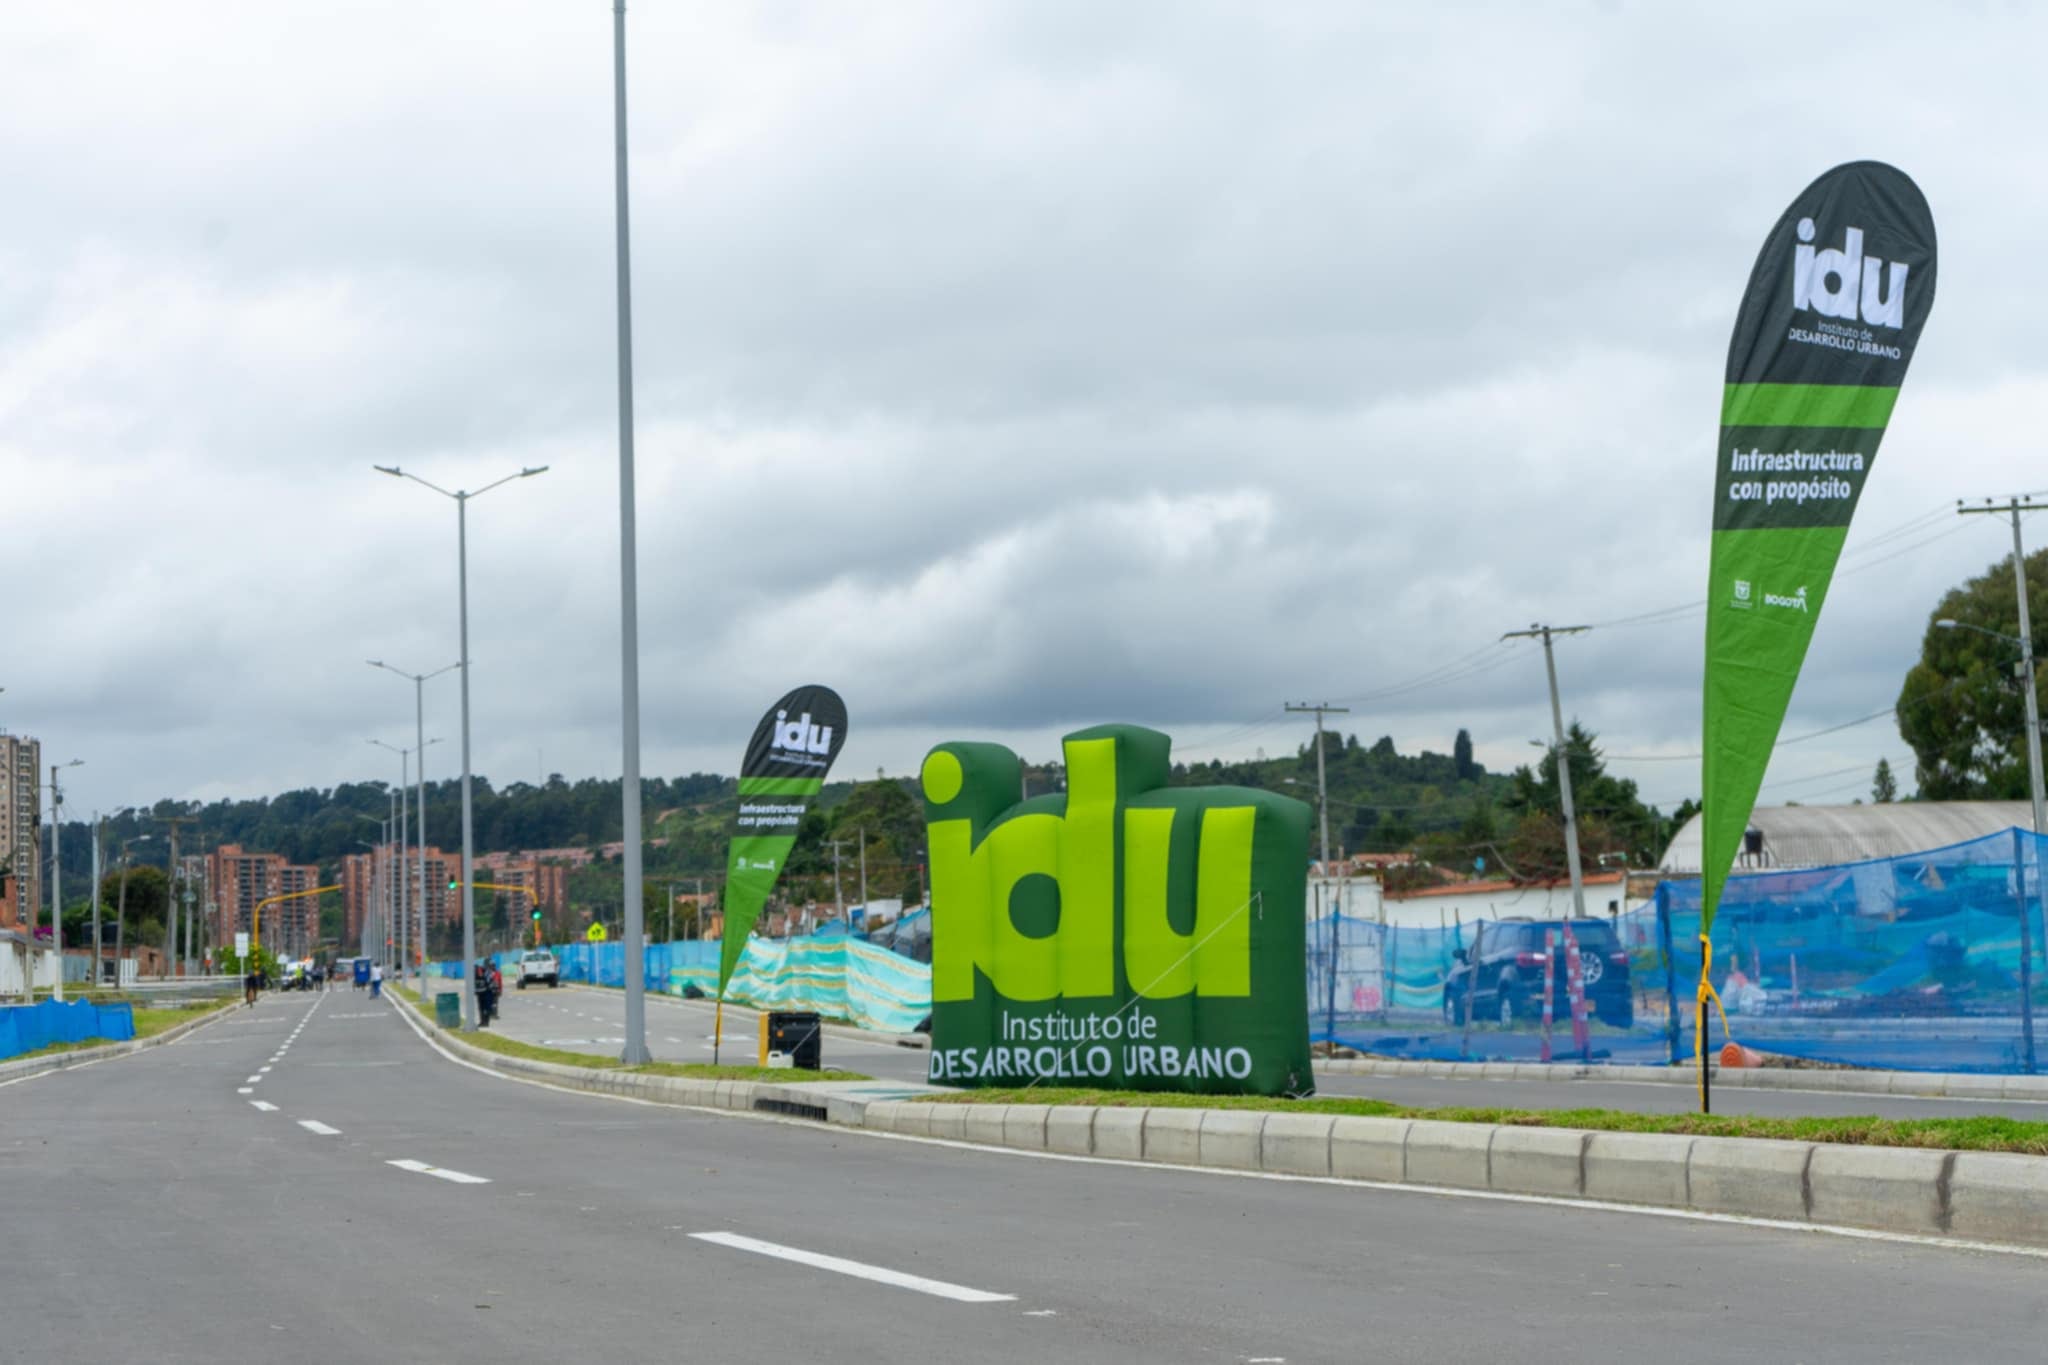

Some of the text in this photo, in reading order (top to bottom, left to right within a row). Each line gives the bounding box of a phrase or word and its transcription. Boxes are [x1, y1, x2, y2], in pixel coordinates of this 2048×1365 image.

[1793, 217, 1909, 329] idu
[1788, 328, 1901, 359] DESARROLLO URBANO
[1817, 320, 1873, 341] Instituto de
[1731, 448, 1864, 472] Infraestructura
[1729, 475, 1852, 505] con propósito
[772, 709, 833, 755] idu
[922, 737, 1256, 1002] idu
[1002, 1006, 1157, 1041] Instituto de
[930, 1045, 1253, 1080] DESARROLLO URBANO
